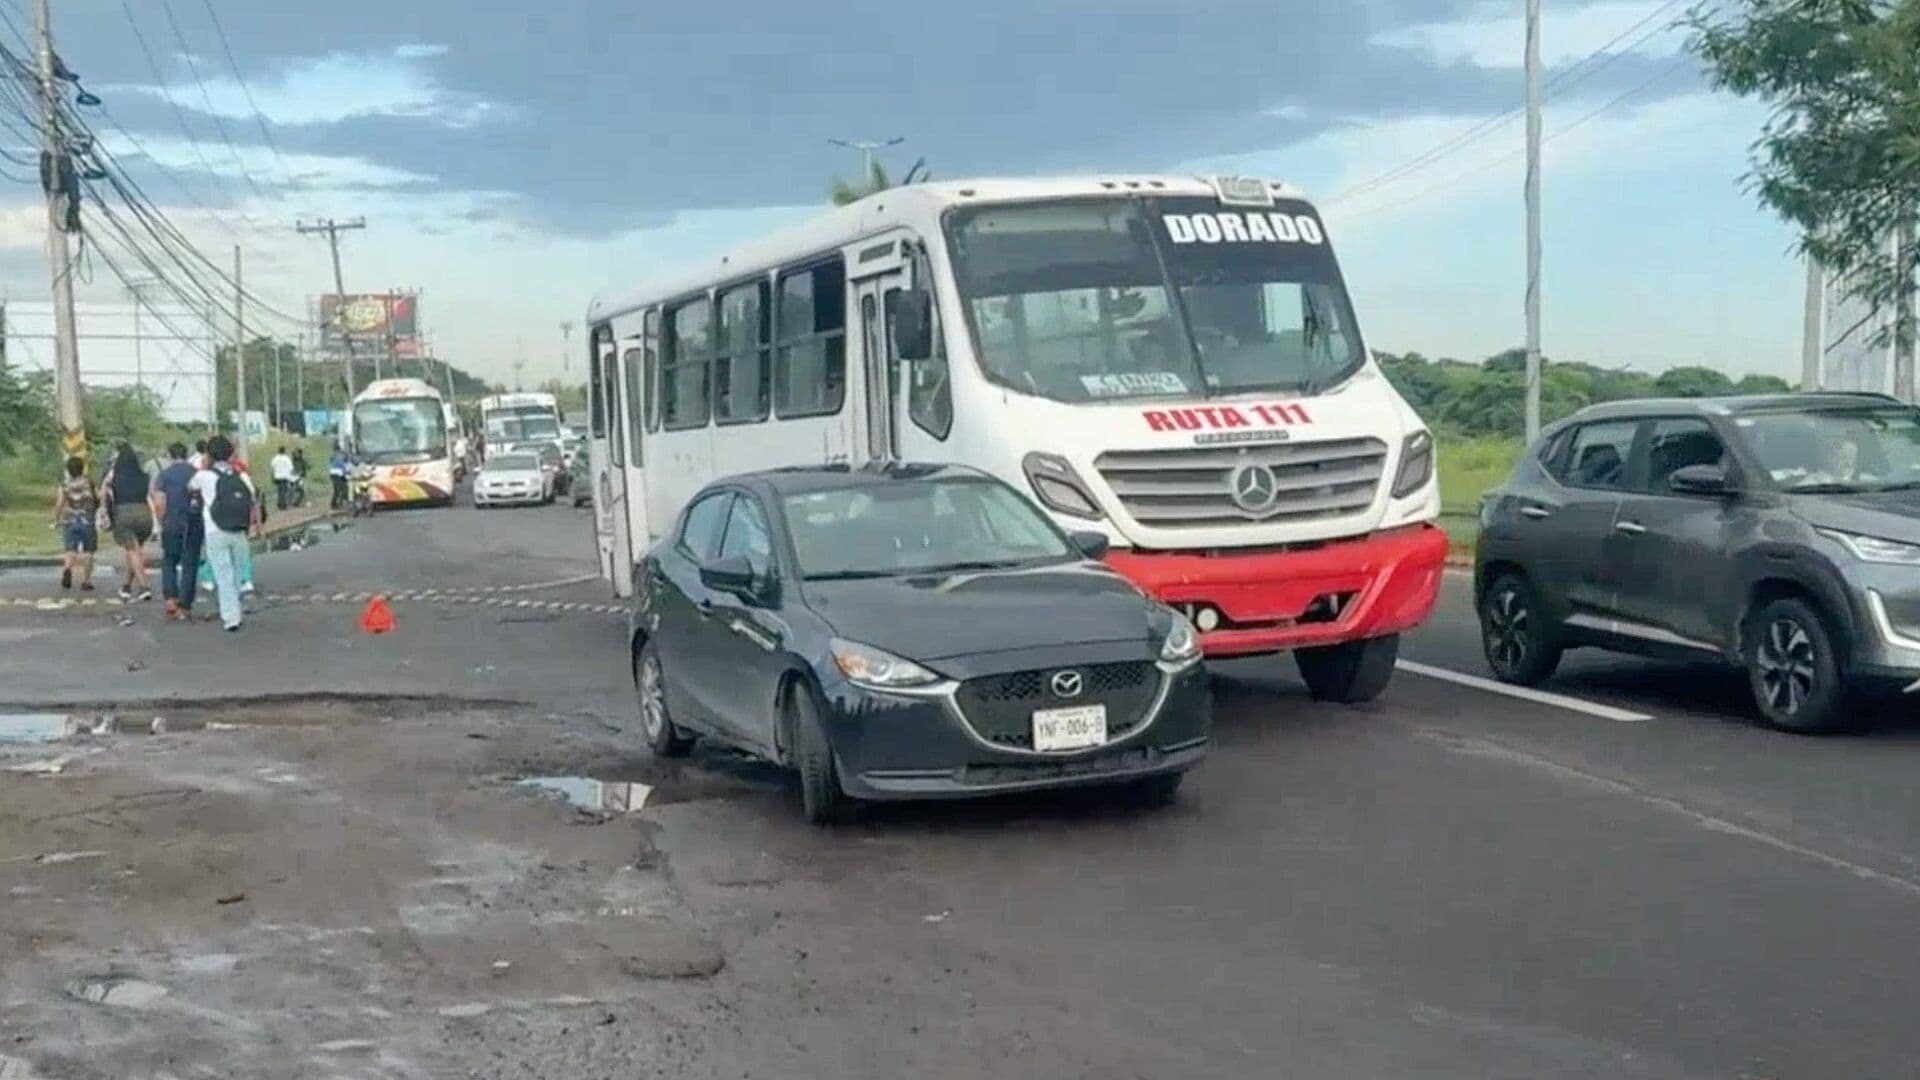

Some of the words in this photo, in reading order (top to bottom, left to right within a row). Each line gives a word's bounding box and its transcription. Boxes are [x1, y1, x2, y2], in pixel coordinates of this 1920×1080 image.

[1163, 213, 1322, 244] DORADO
[1142, 407, 1250, 431] RUTA
[1252, 403, 1312, 425] 111
